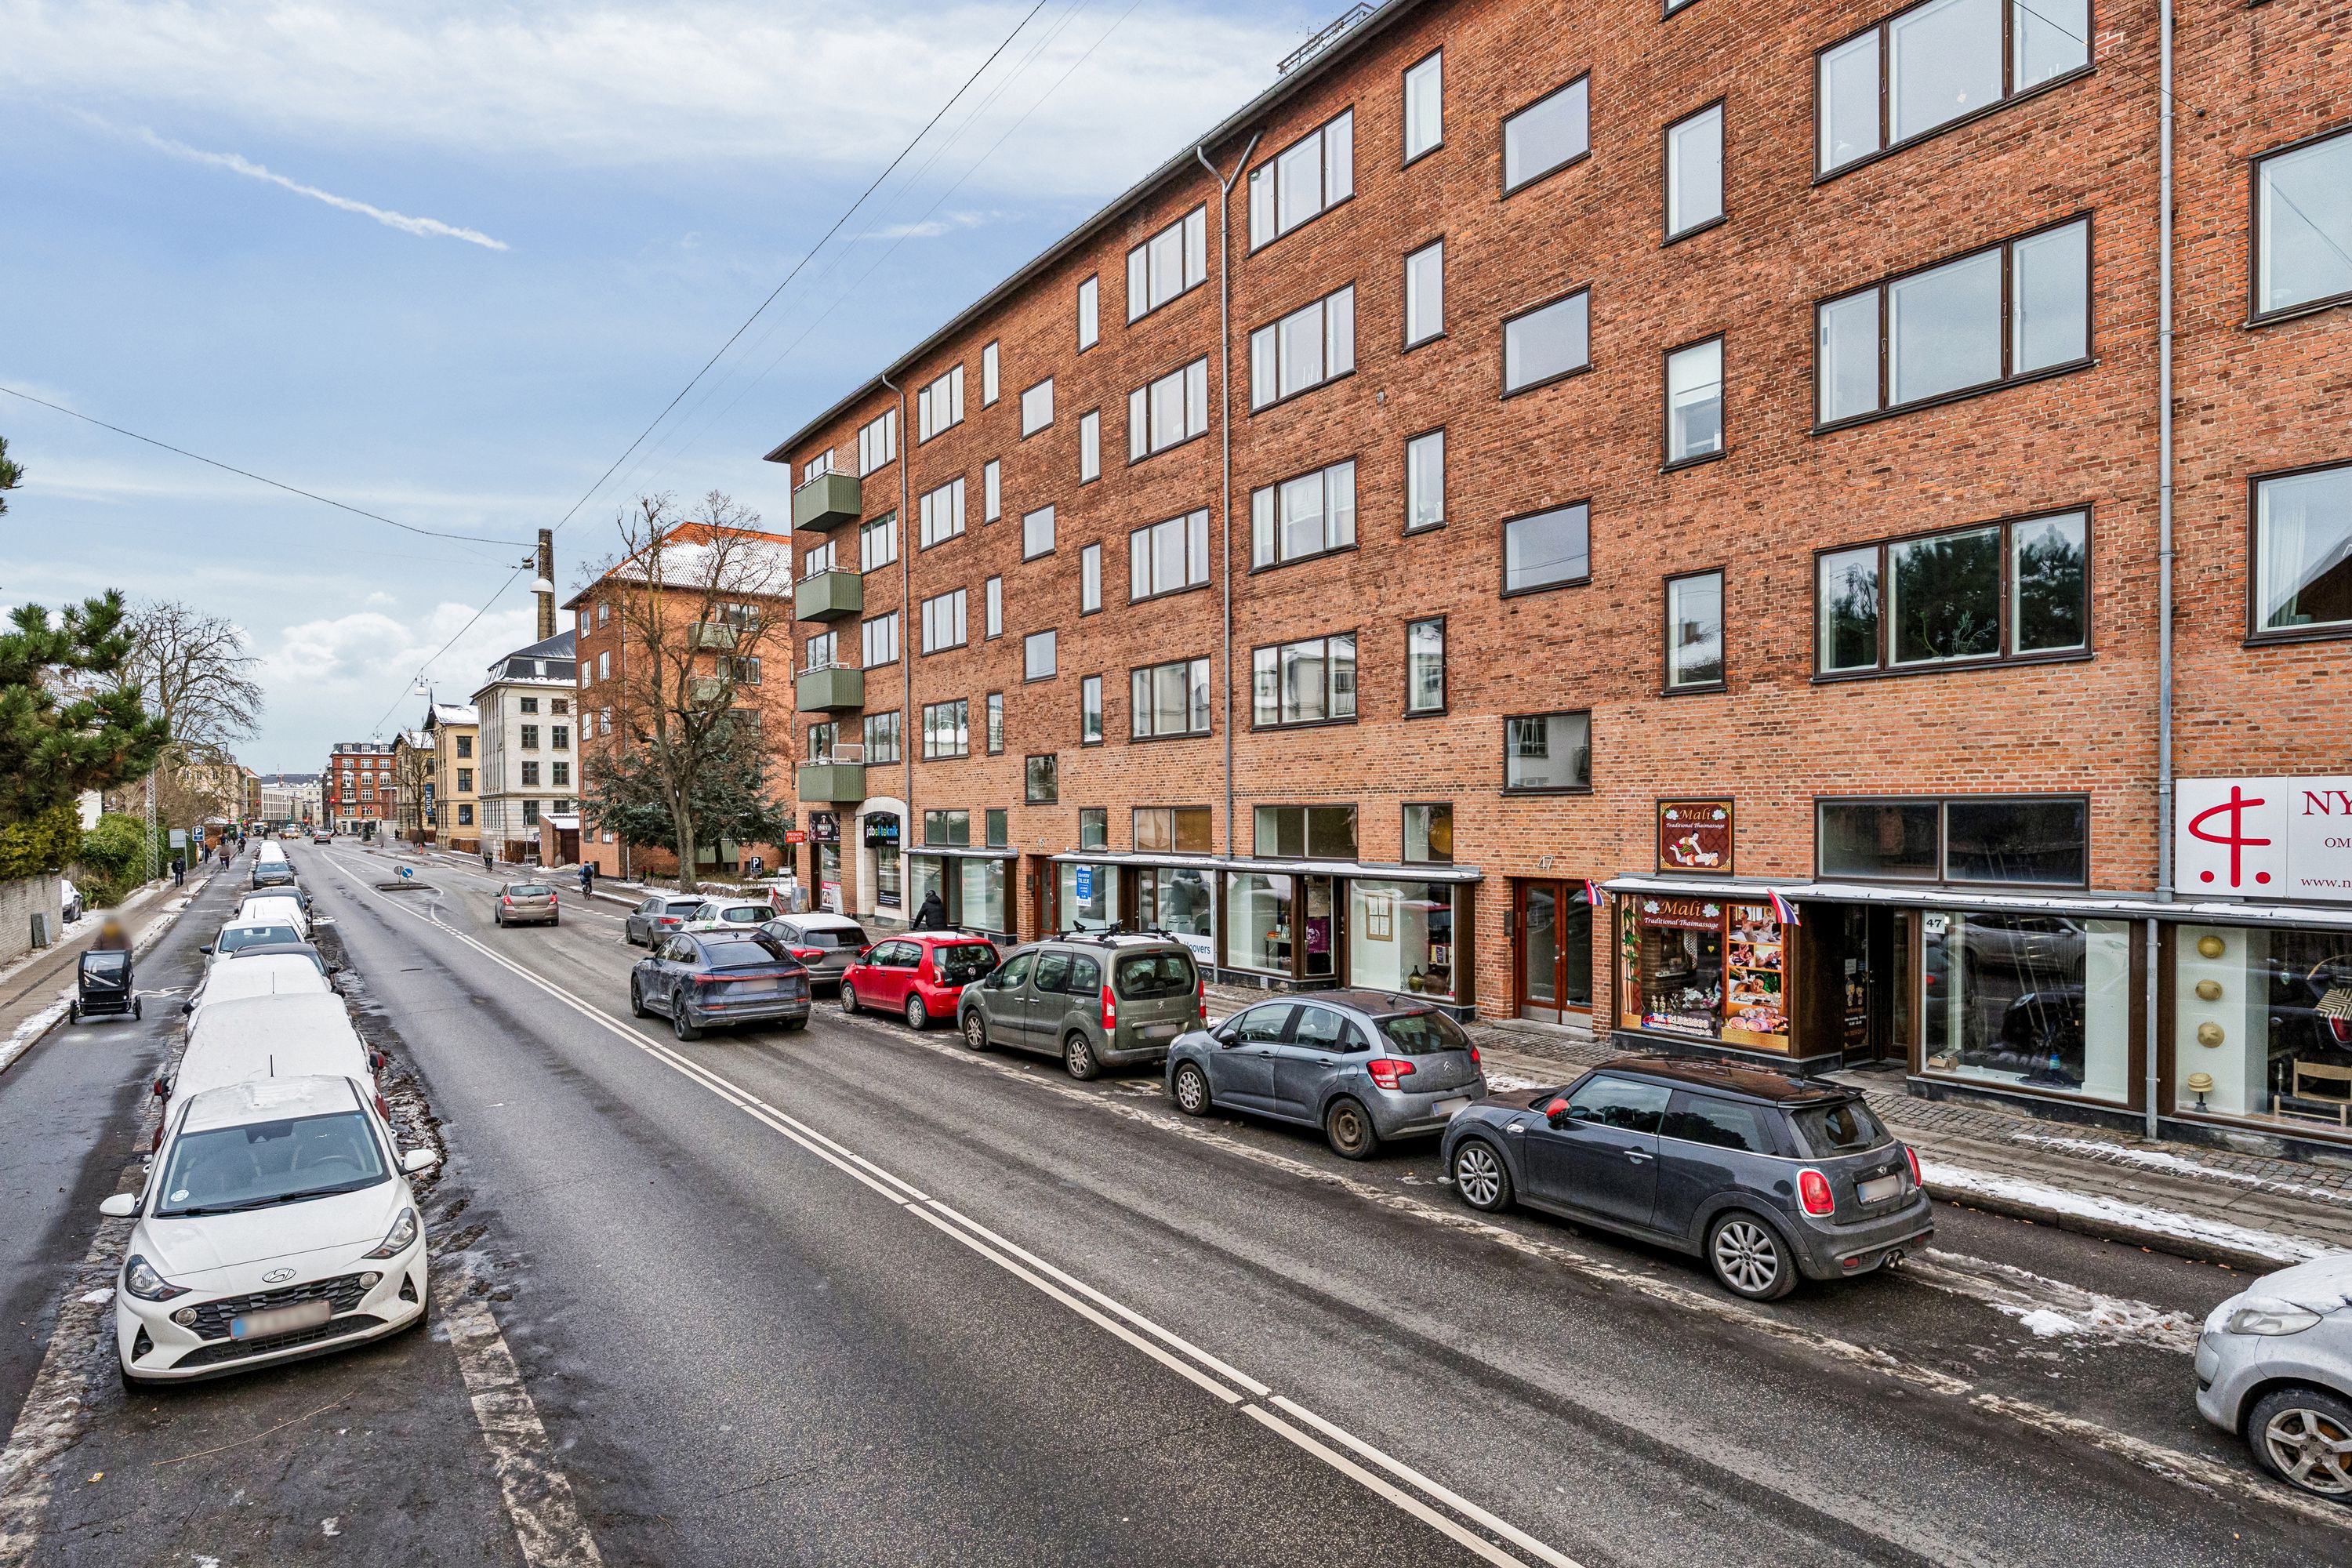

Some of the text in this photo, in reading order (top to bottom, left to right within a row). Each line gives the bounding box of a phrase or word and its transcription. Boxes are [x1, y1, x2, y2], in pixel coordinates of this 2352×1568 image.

[1679, 808, 1711, 820] Mali
[866, 826, 898, 838] jdbel-teknik
[753, 858, 759, 868] P
[1537, 855, 1553, 870] 47
[1660, 901, 1701, 916] Mali
[1679, 919, 1719, 930] Thaimassage
[1926, 919, 1942, 927] 47
